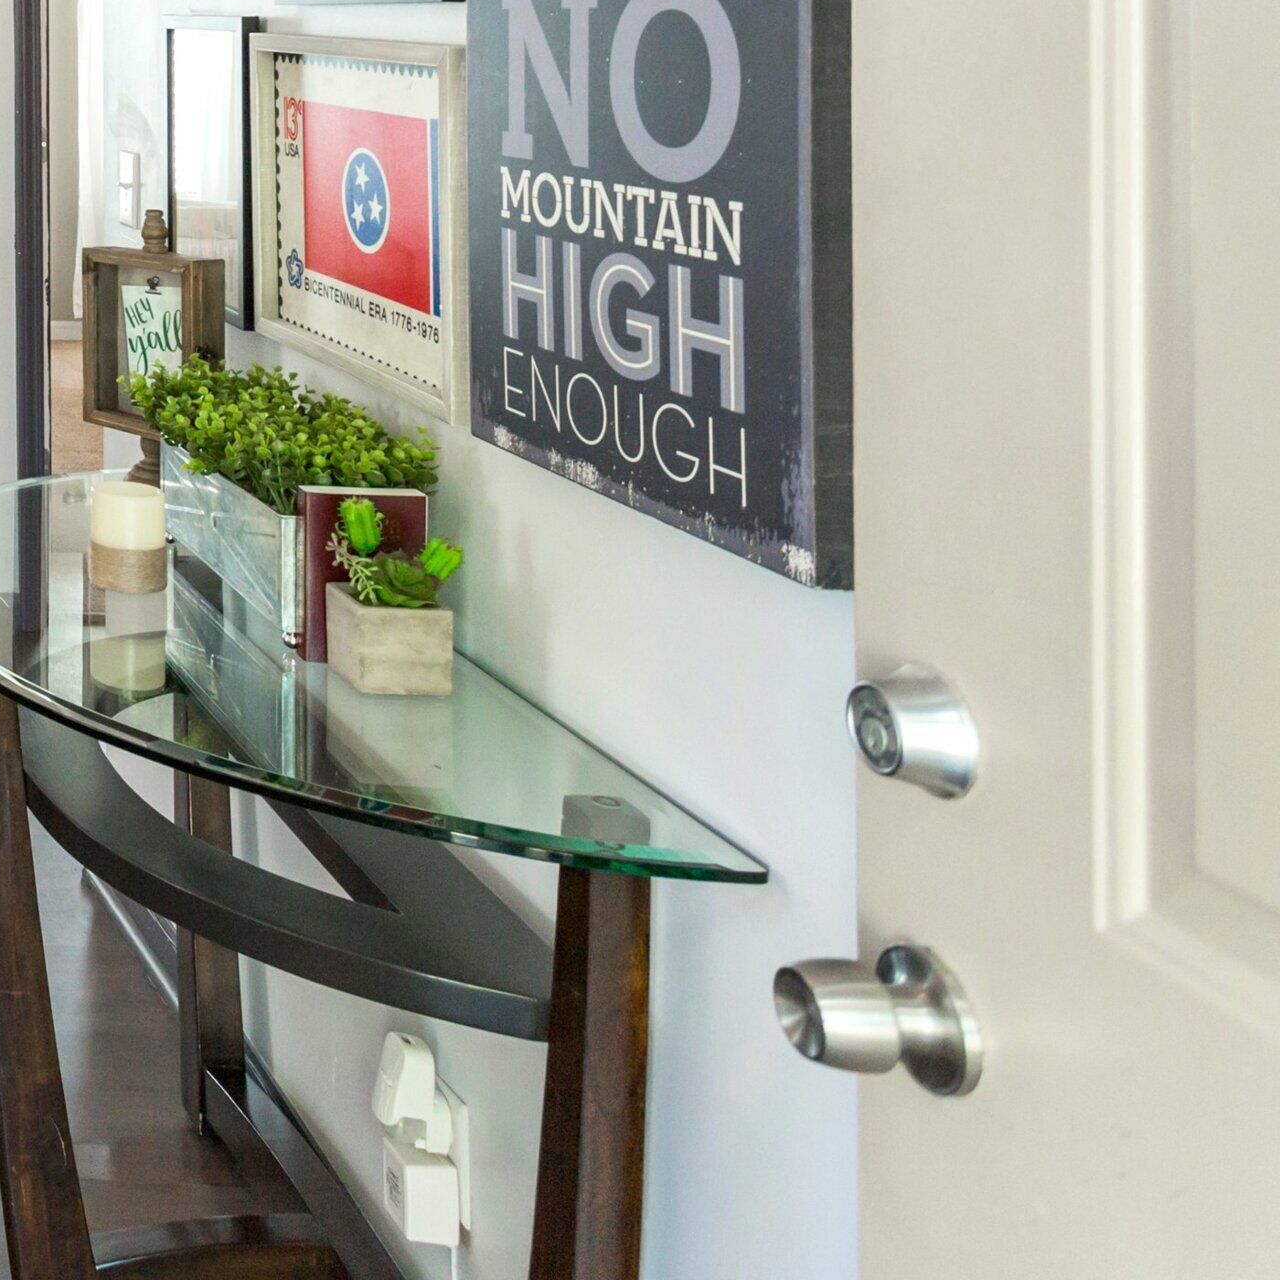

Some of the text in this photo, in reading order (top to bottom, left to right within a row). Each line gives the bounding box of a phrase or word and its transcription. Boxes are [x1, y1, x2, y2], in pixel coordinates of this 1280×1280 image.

[284, 142, 300, 159] USA
[500, 166, 744, 266] MOUNTAIN
[125, 297, 154, 329] HEY
[128, 309, 182, 376] y'all
[304, 276, 440, 345] BICENTENNIAL ERA 1776-1976
[501, 228, 745, 414] HIGH
[503, 346, 747, 509] ENOUGH
